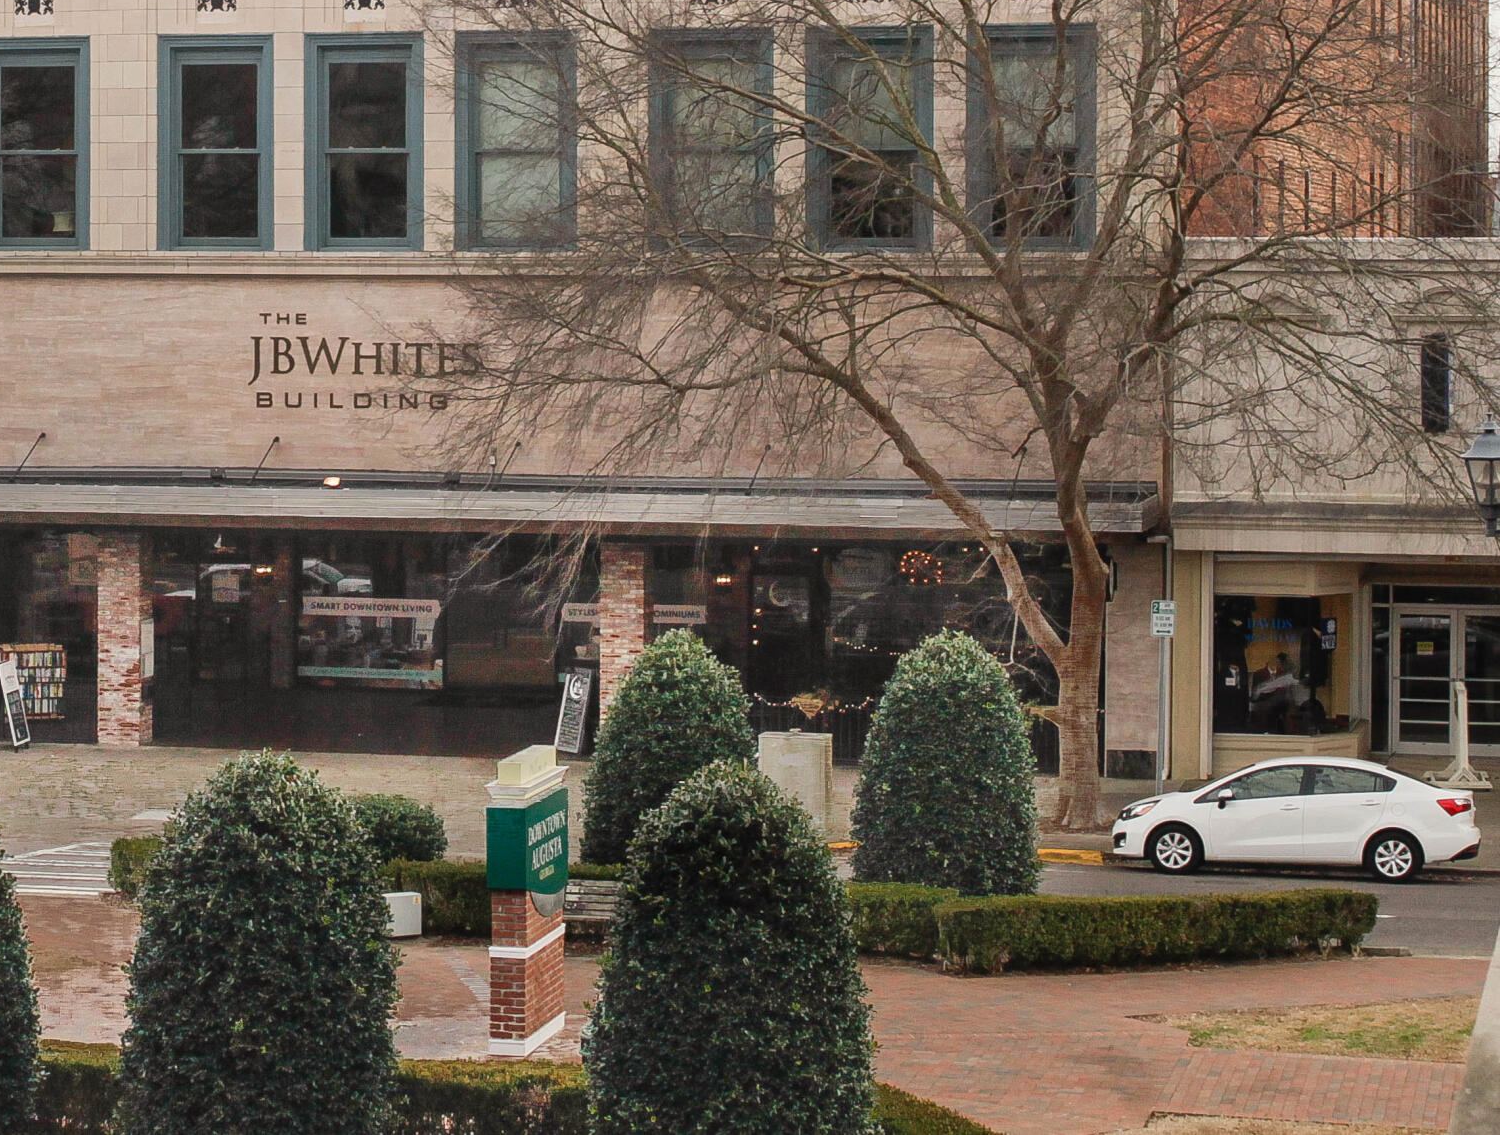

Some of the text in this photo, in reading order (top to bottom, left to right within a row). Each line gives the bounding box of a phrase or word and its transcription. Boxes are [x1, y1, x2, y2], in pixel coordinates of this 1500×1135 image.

[259, 312, 308, 325] THE
[256, 392, 449, 411] BUILDING
[310, 601, 433, 613] SMART DOWNTOWN LIVING
[1153, 603, 1159, 612] 2
[528, 808, 566, 847] DOWNTOWN
[532, 836, 563, 871] AUGUSTA
